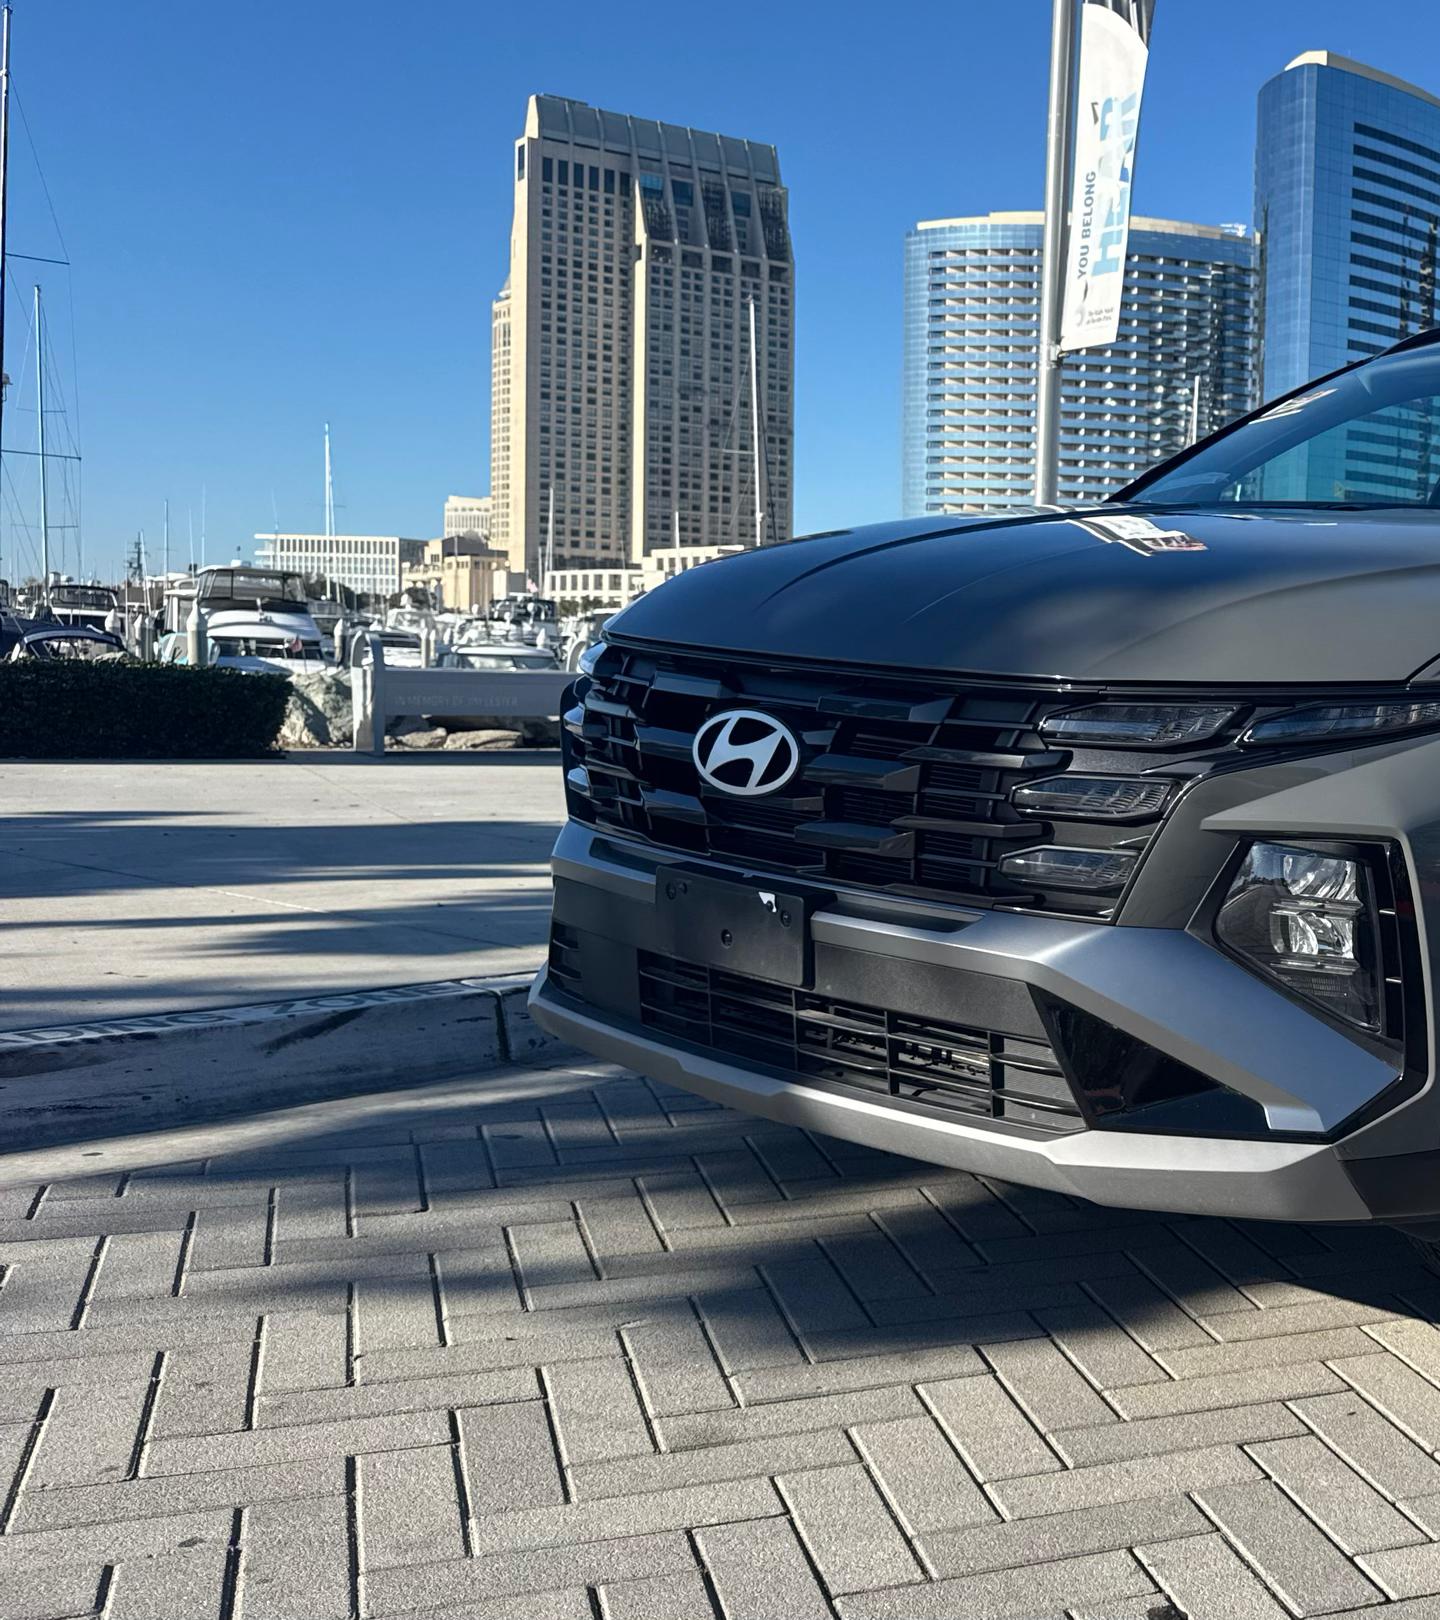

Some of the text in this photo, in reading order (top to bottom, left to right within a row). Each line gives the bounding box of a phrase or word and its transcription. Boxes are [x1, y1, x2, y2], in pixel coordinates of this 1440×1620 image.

[1077, 171, 1096, 280] YOU BELONG
[251, 986, 466, 1015] ZONE
